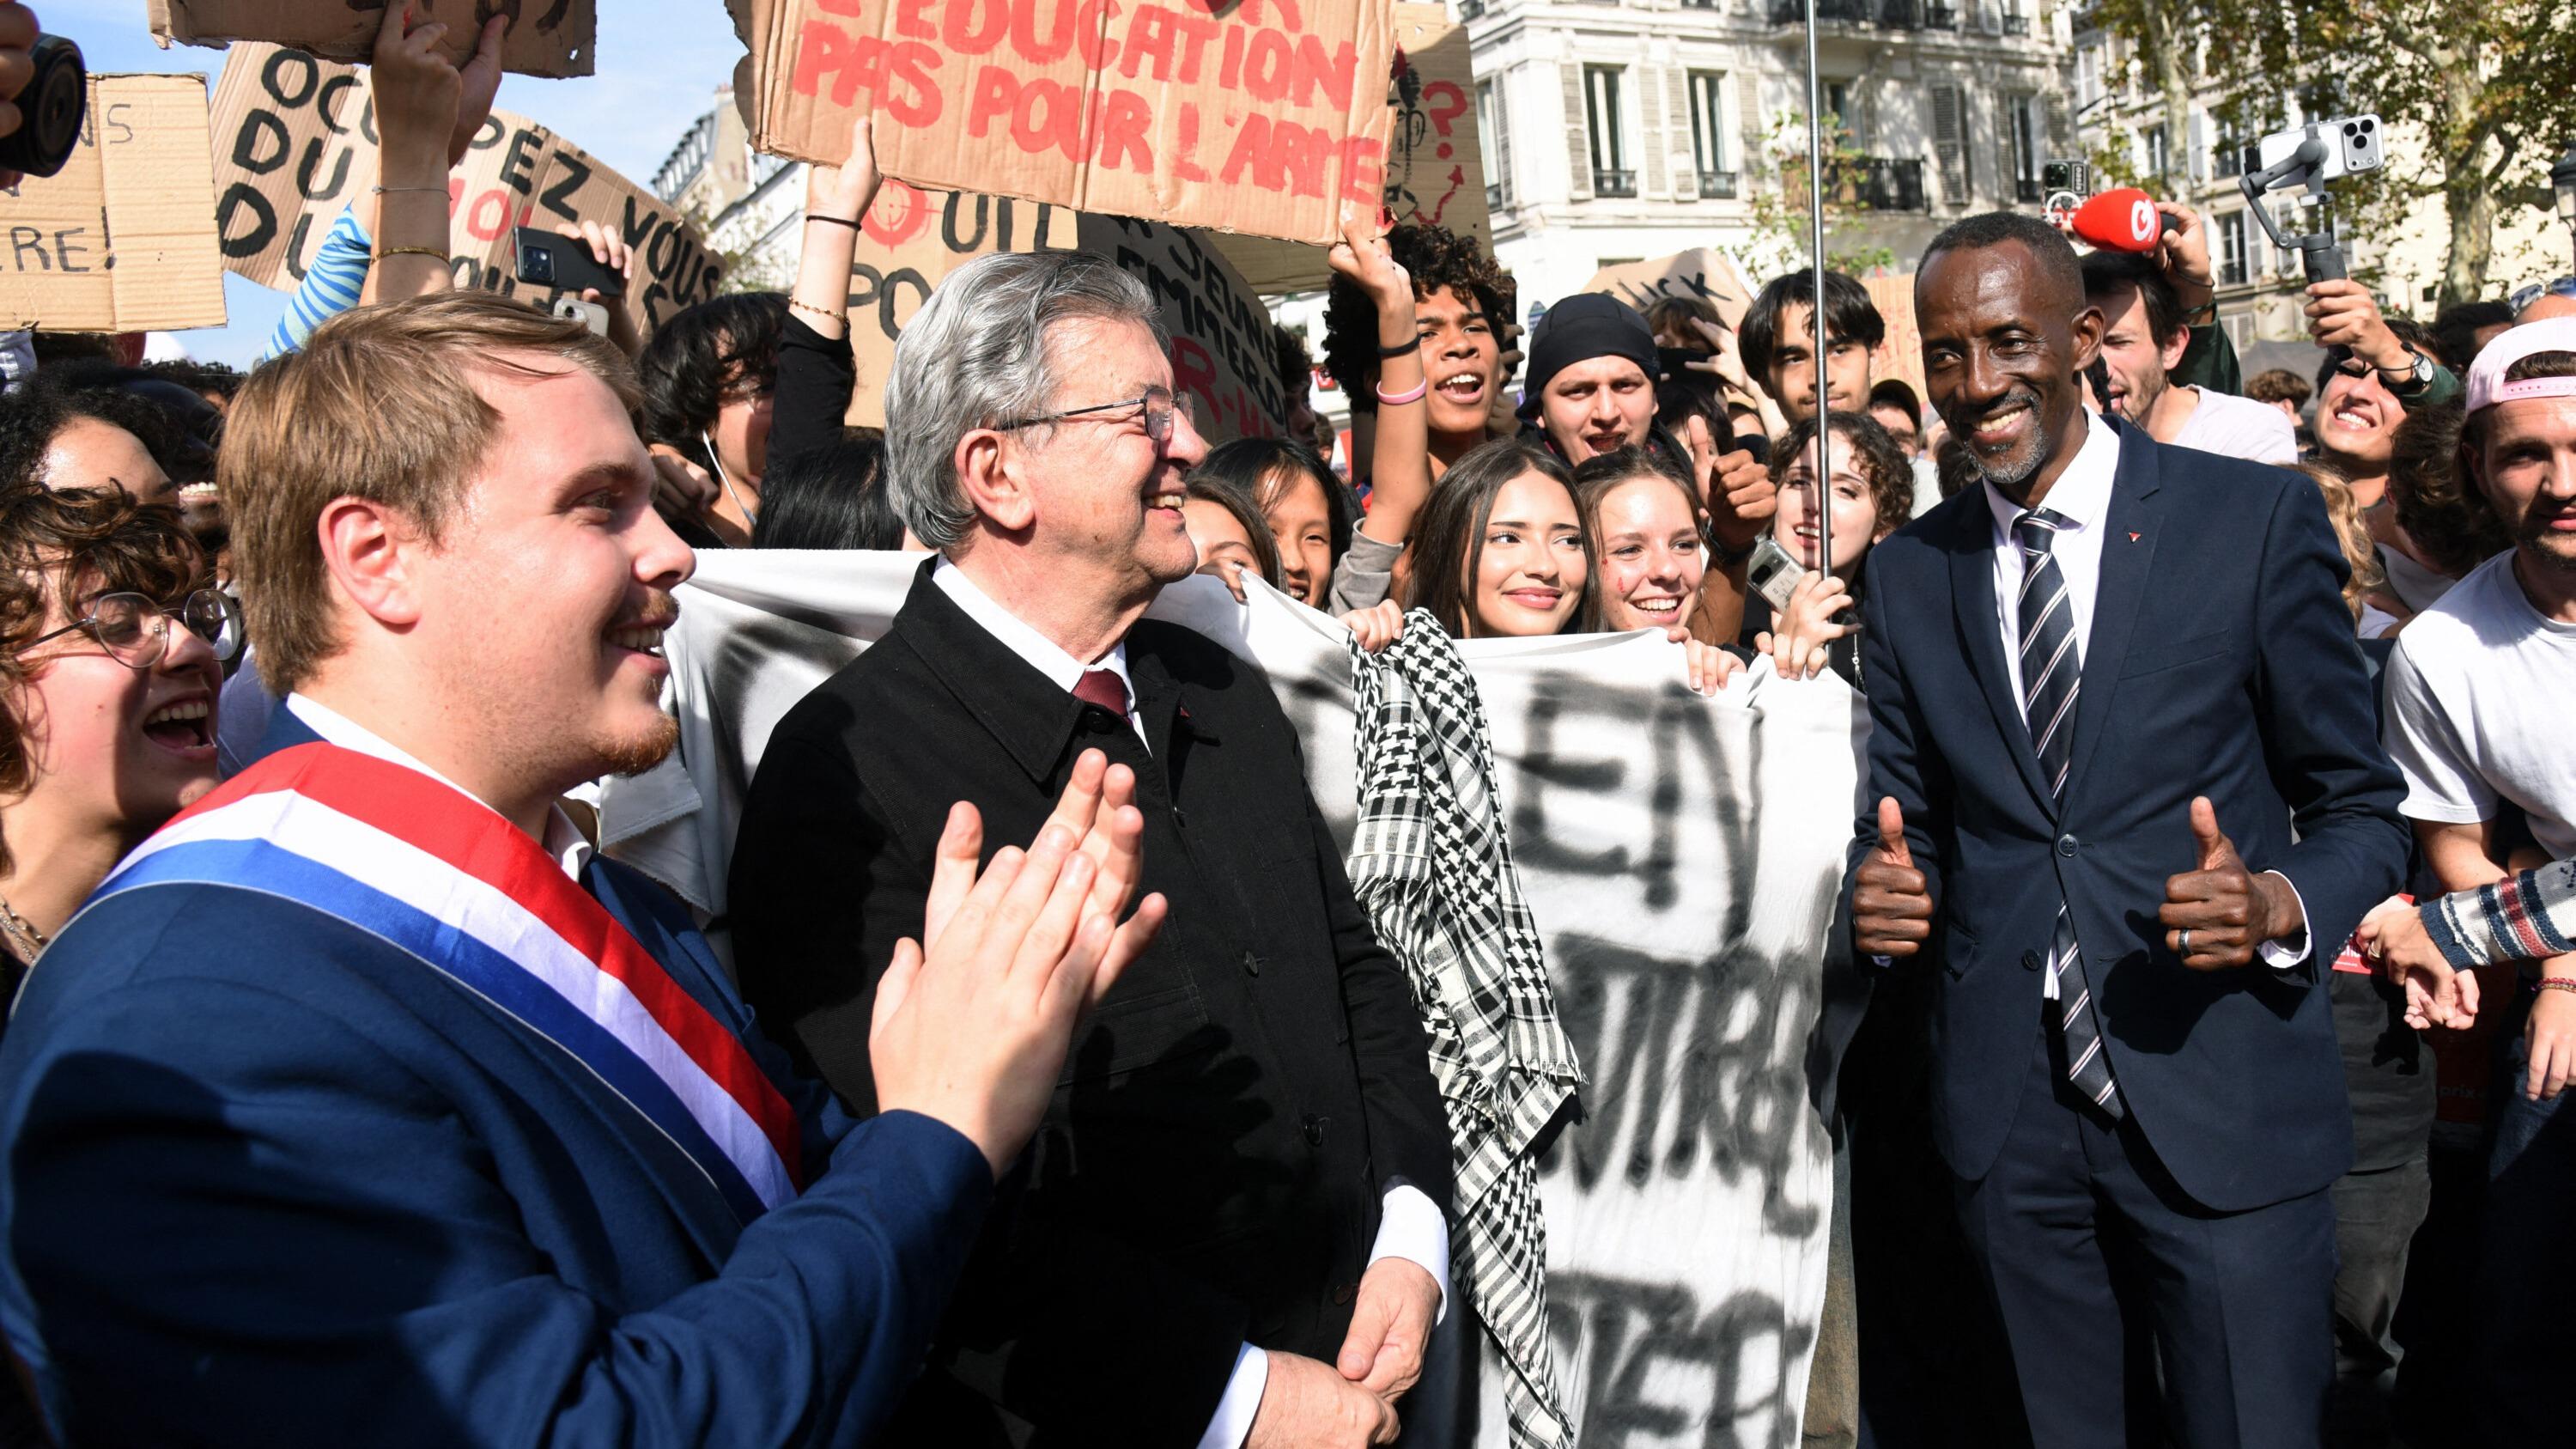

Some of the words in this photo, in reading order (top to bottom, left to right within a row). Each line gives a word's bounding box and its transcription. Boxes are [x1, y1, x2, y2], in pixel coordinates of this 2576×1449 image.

[232, 108, 354, 201] DU
[793, 19, 944, 128] PAS
[968, 65, 1155, 176] POUR
